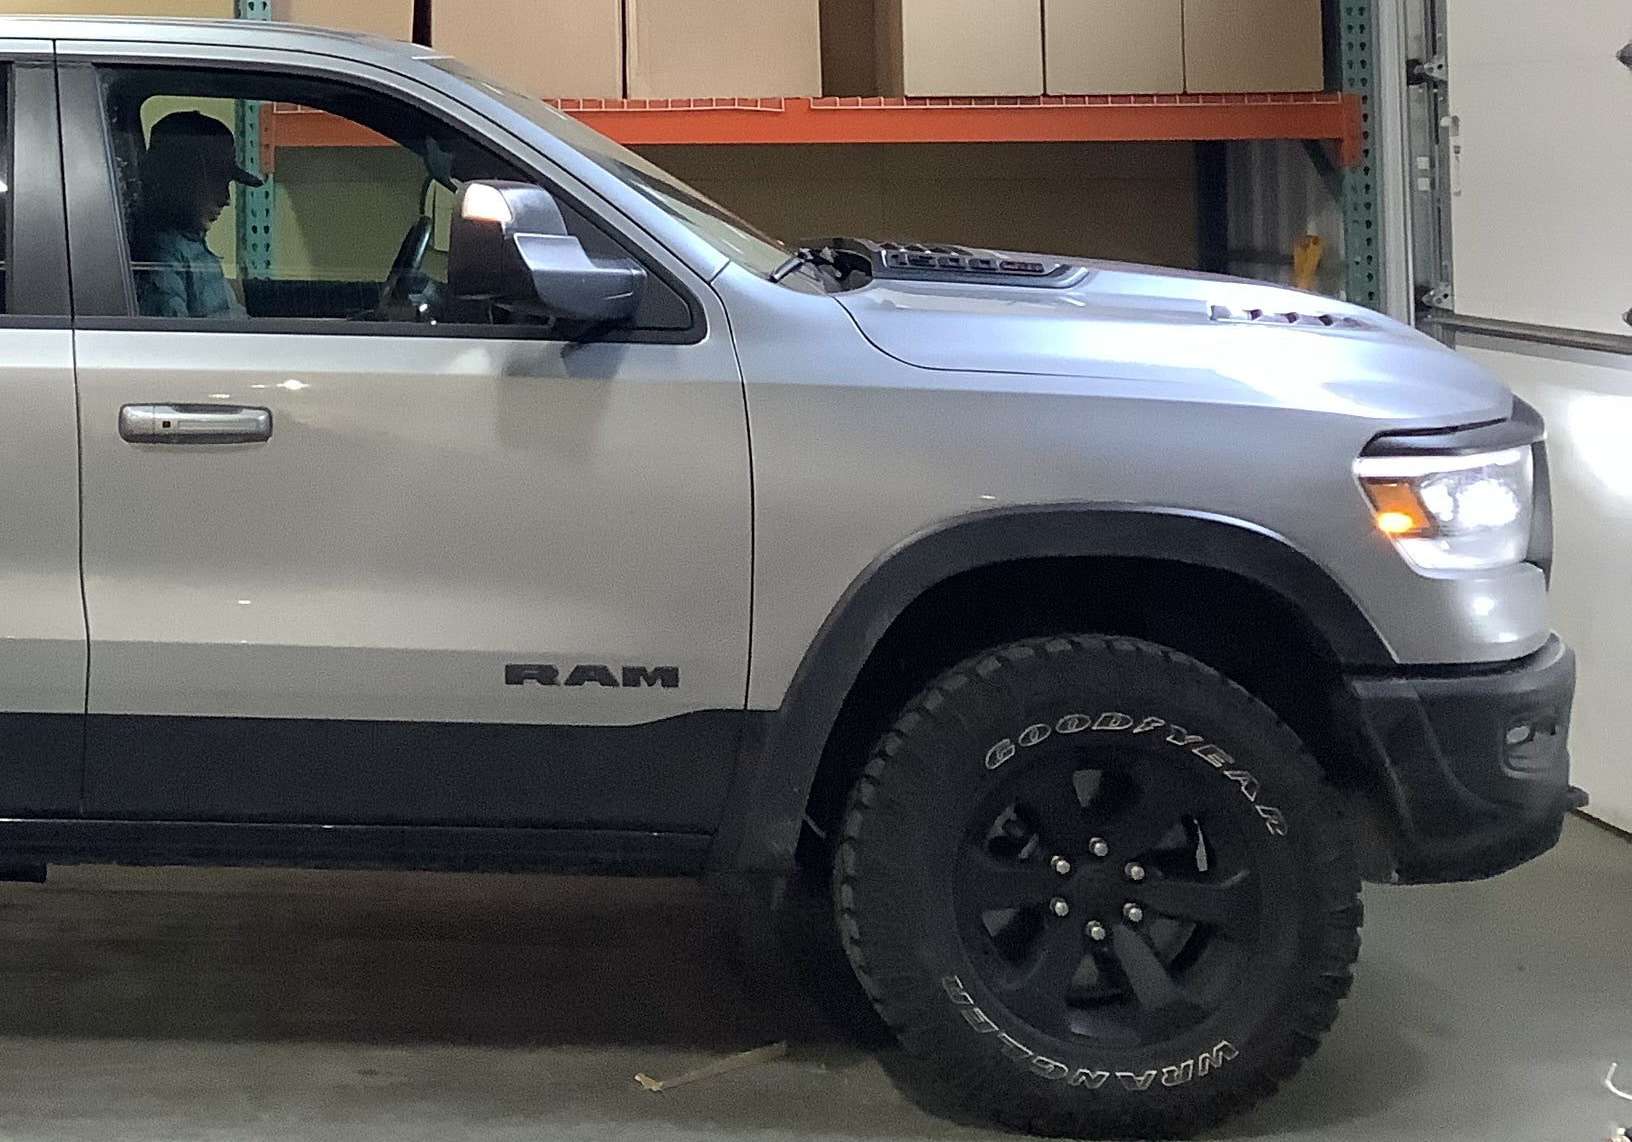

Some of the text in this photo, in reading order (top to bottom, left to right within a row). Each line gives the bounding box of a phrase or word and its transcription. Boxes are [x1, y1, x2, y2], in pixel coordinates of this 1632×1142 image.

[505, 664, 679, 688] RAM
[985, 711, 1289, 836] GOODYEAR
[941, 975, 1239, 1091] WRANGLER
